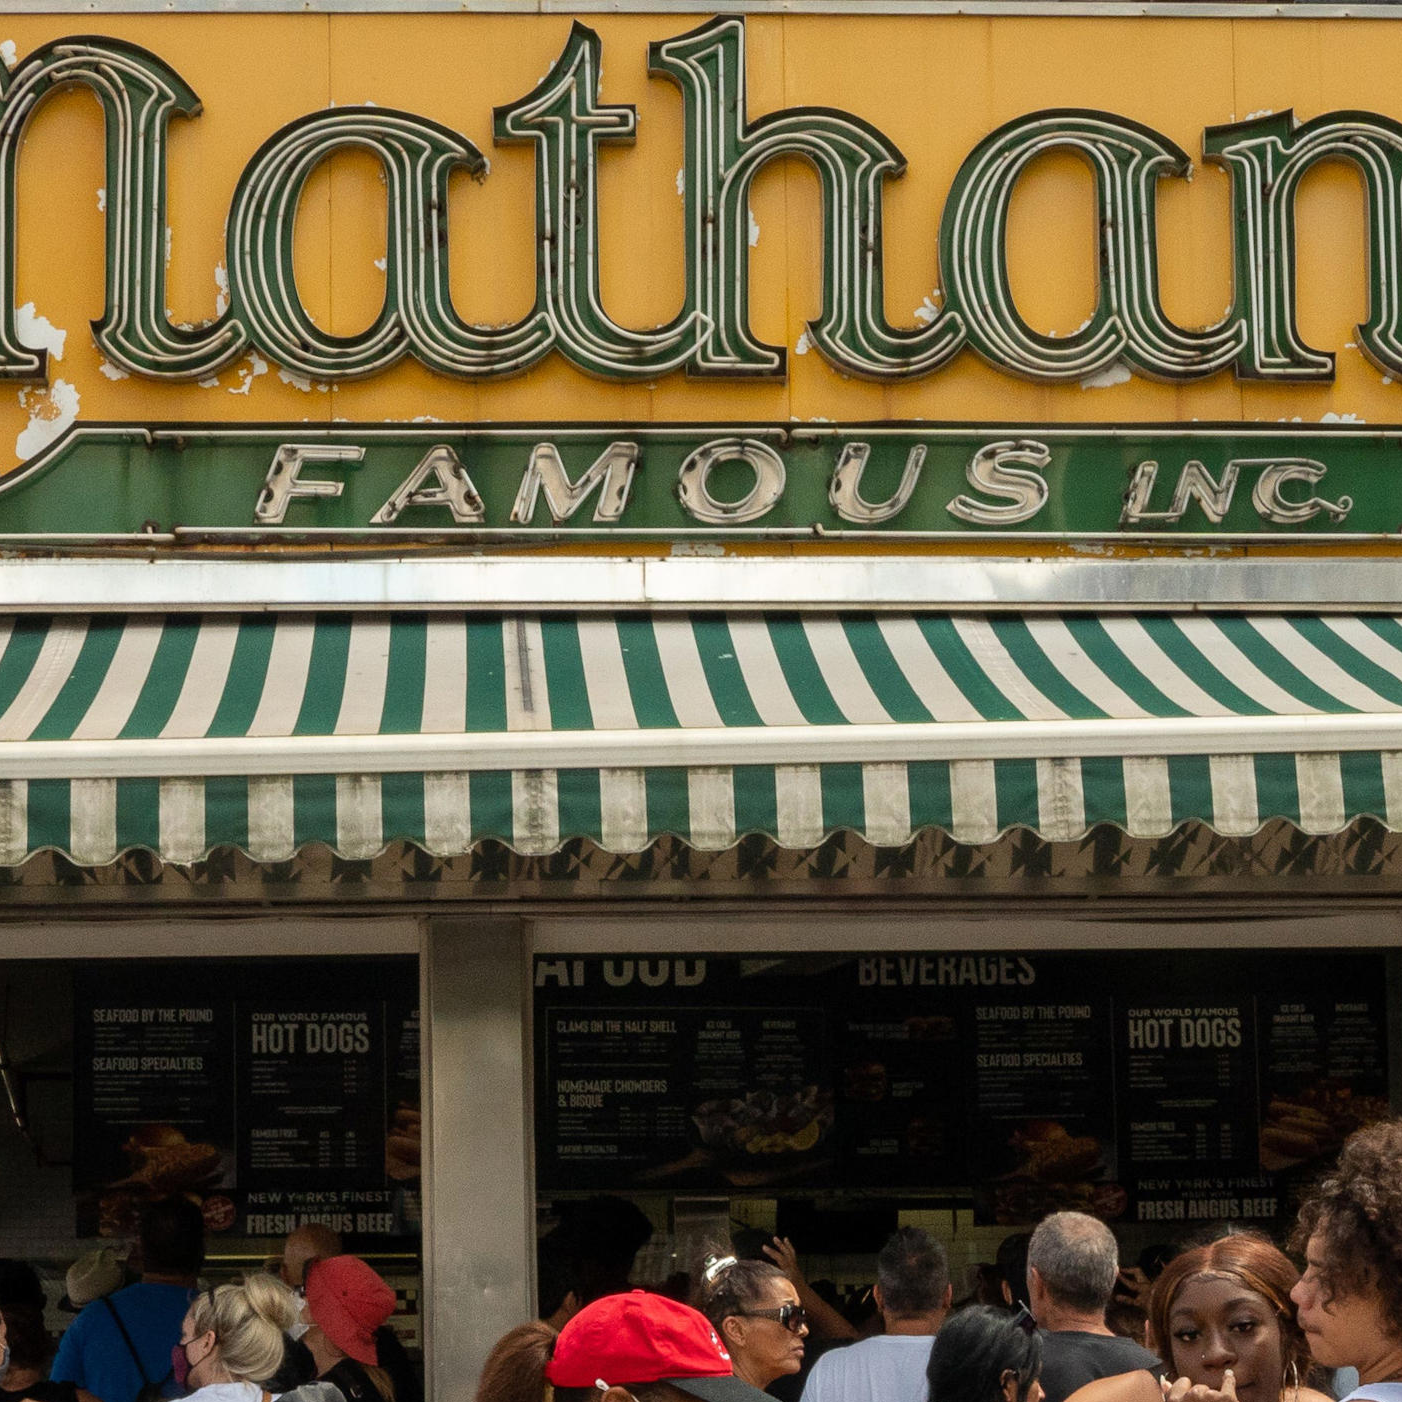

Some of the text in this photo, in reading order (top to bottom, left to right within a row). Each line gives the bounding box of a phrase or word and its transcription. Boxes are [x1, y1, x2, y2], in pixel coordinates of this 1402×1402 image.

[253, 437, 1354, 526] FAMOUS INC.
[93, 1008, 213, 1023] SEAFOOD BY THE POUND
[251, 1012, 367, 1021] OUR WORLD FAMOUS
[976, 1005, 1091, 1020] SEAFOOD BY THE POUND
[1128, 1008, 1238, 1017] OUR WORLD FAMOUS
[556, 1020, 677, 1032] CLAMS ON THE HALF SHELL
[1128, 1018, 1242, 1048] HOT DOGS
[251, 1023, 299, 1054] HOT
[305, 1022, 370, 1054] DOGS
[93, 1056, 204, 1071] SEAFOOD SPECIALTIES
[977, 1052, 1083, 1067] SEAFOOD SPECIALTIES
[558, 1080, 667, 1093] HOMEMADE CHOWDERS
[558, 1095, 604, 1108] & BISQUE
[1138, 1179, 1170, 1190] NEW
[1228, 1177, 1276, 1188] FINEST
[248, 1192, 282, 1204] NEW
[342, 1191, 392, 1203] FINEST
[1137, 1198, 1278, 1220] FRESH ANGUS BEEF
[246, 1214, 296, 1234] FRESH
[356, 1213, 393, 1233] BEEF
